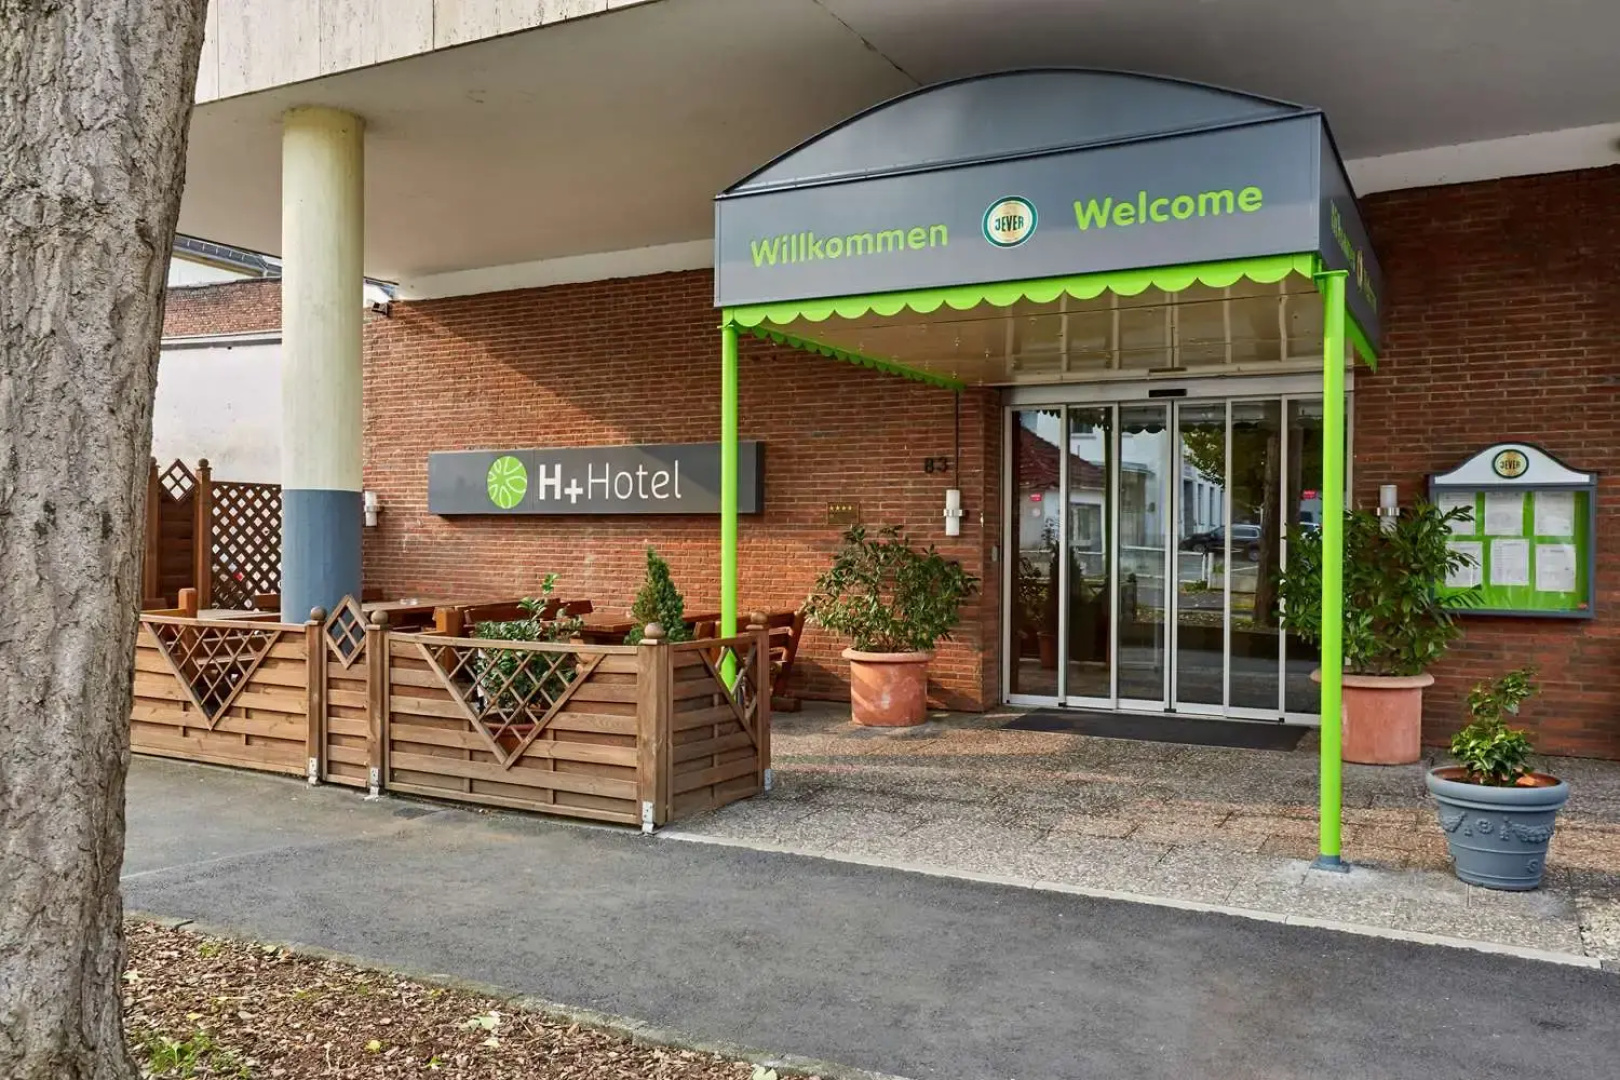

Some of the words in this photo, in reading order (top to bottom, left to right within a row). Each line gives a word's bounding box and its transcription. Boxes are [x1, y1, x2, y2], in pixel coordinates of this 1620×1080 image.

[995, 215, 1024, 232] JEVER
[1074, 186, 1262, 230] Welcome
[751, 224, 948, 268] Willkommen
[539, 460, 682, 504] H+Hotel
